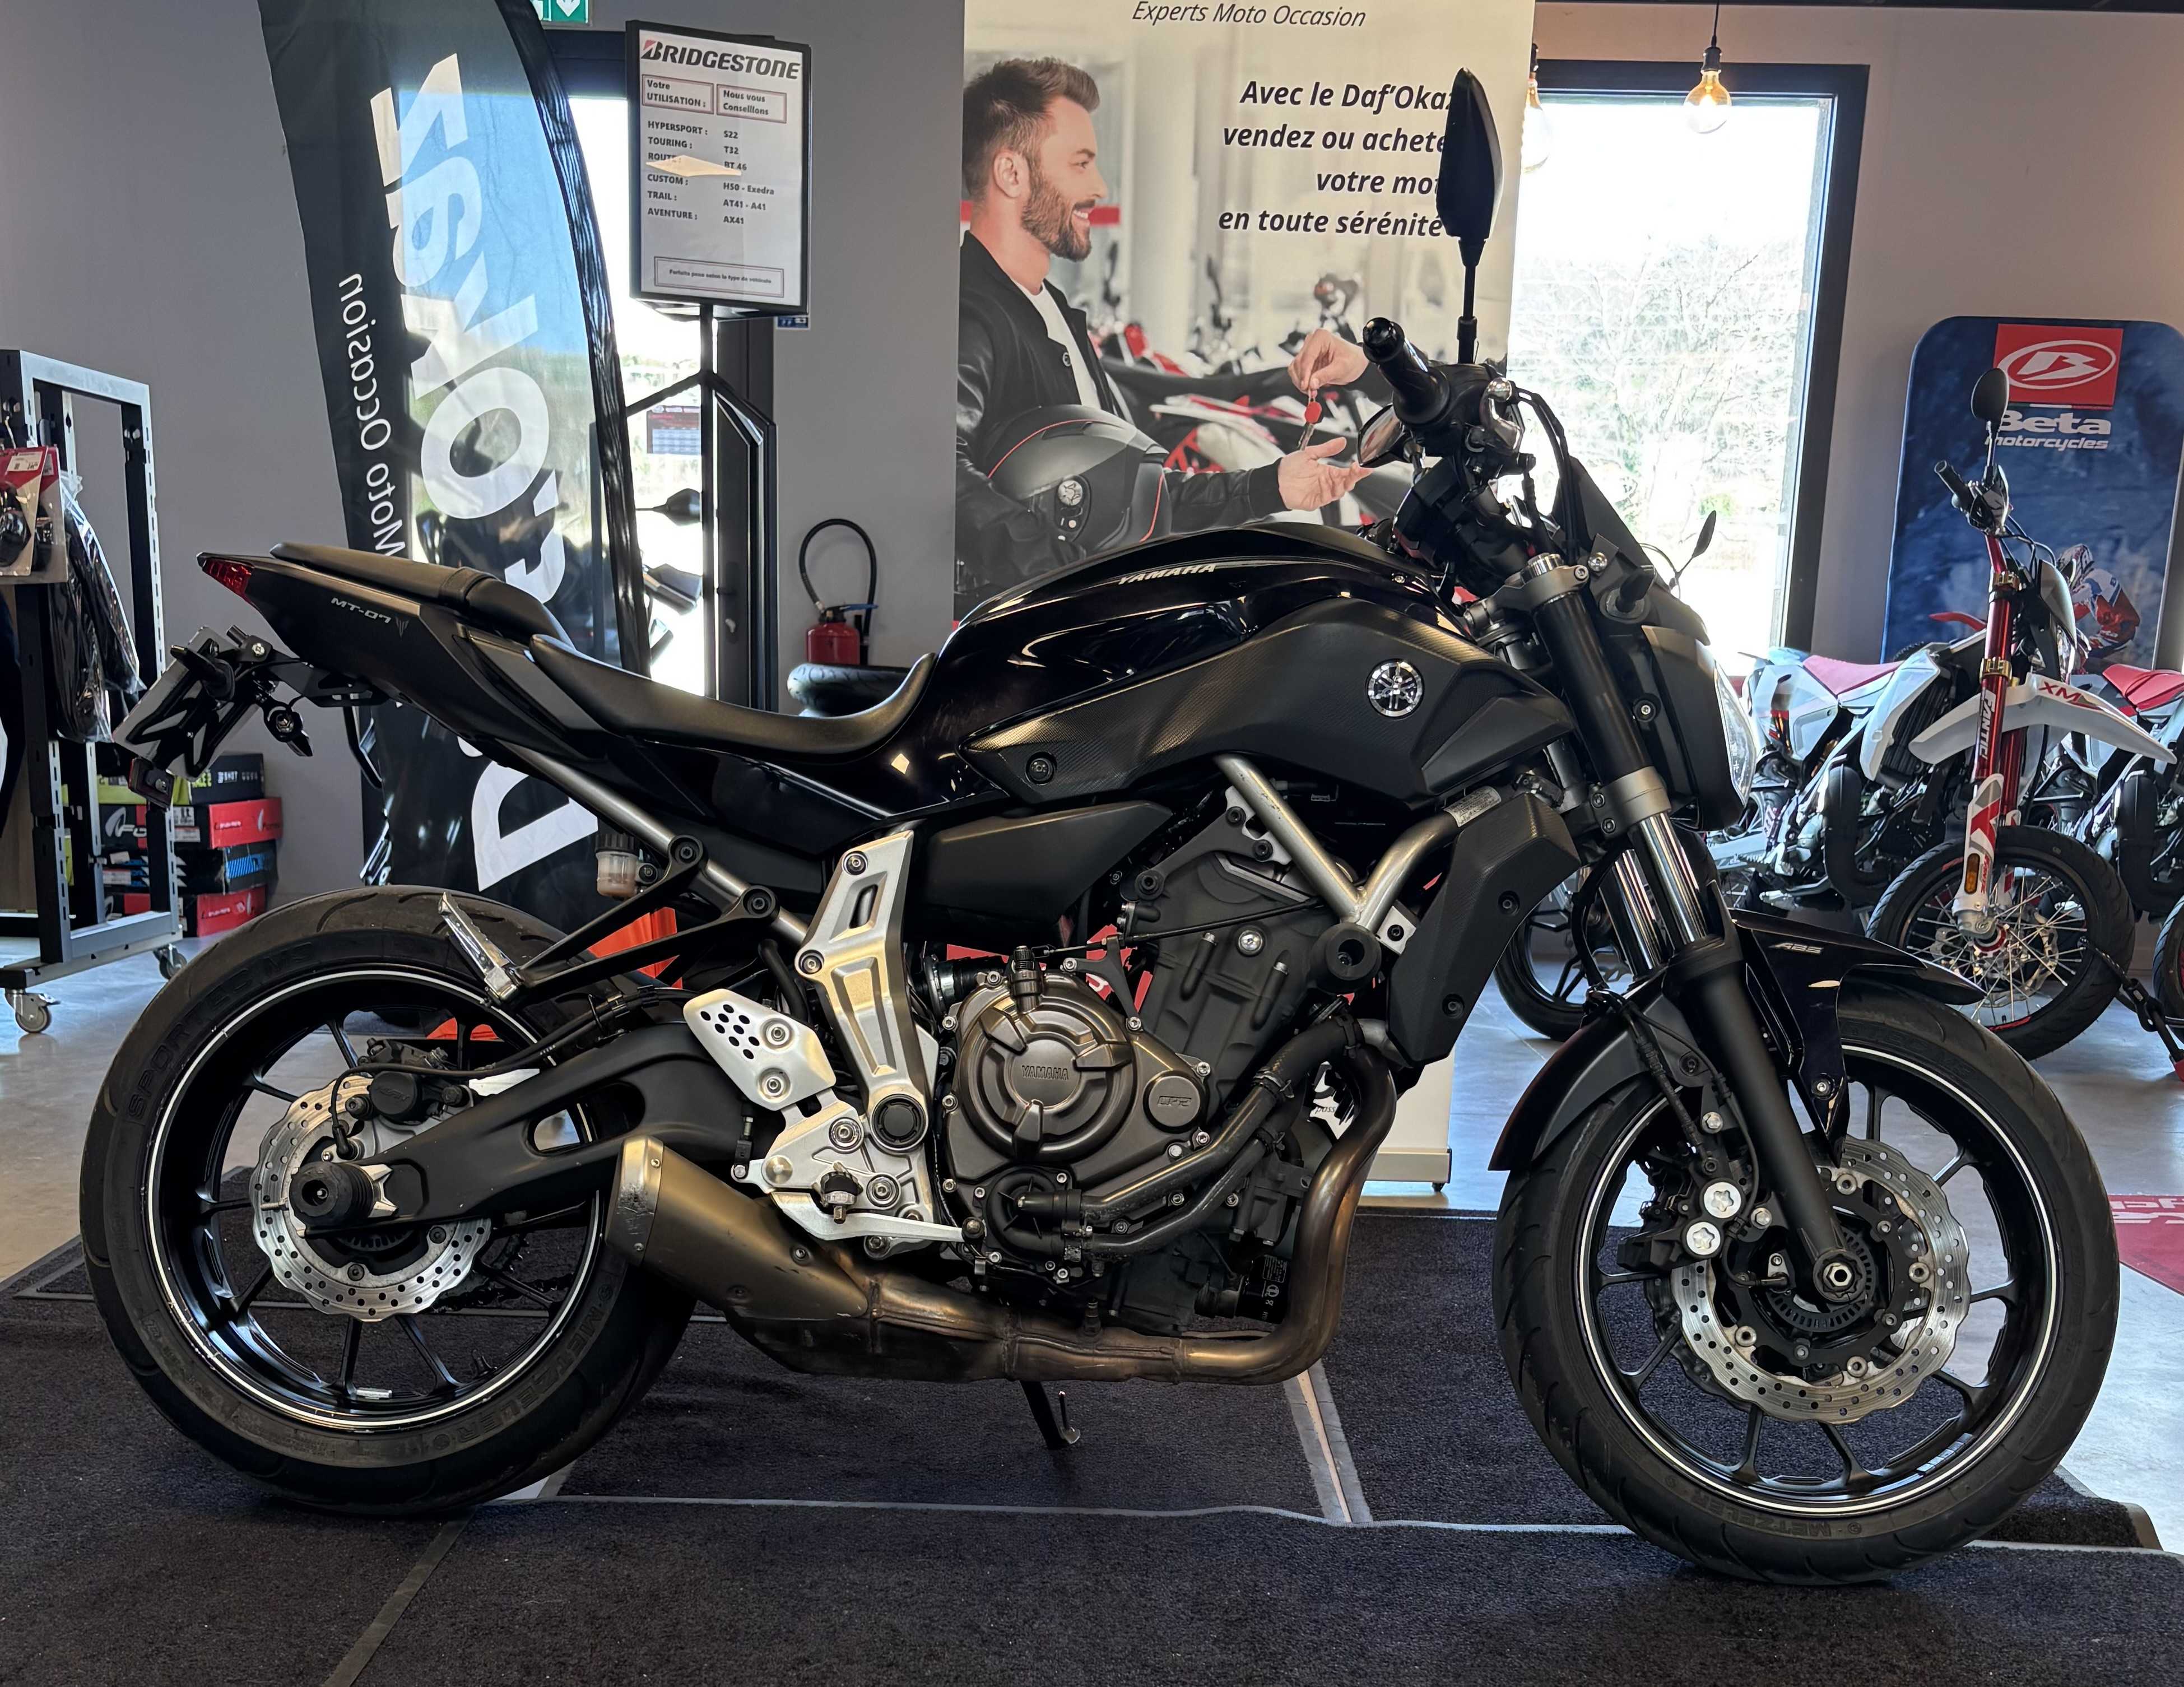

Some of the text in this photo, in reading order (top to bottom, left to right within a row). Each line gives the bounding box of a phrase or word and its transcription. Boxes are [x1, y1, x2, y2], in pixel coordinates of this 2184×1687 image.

[1132, 1, 1367, 27] Experts Moto Occasion
[640, 40, 801, 80] BRIDGESTONE
[647, 80, 671, 90] Votre
[647, 92, 701, 107] UTILISATION
[723, 90, 745, 100] Nous
[1239, 81, 1303, 105] Avec
[1310, 82, 1334, 106] le
[647, 120, 703, 135] HYPERSPORT
[723, 131, 738, 139] S22
[648, 137, 688, 148] TOURING
[1224, 124, 1446, 152] vendez ou achete
[724, 146, 740, 155] T32
[647, 174, 683, 185] CUSTOM
[1317, 171, 1385, 193] votre
[647, 190, 672, 201] TRAIL
[723, 182, 740, 191] H50
[747, 185, 774, 195] Exedra
[723, 199, 744, 208] AT41
[750, 202, 766, 211] A41
[647, 208, 693, 220] AVENTURE
[723, 216, 744, 225] AX41
[1219, 210, 1443, 237] en toute sérénité
[1999, 410, 2111, 435] Beta
[1118, 563, 1216, 585] YAMAHA
[331, 597, 392, 624] MT-07
[1021, 1065, 1070, 1081] YAMAHA
